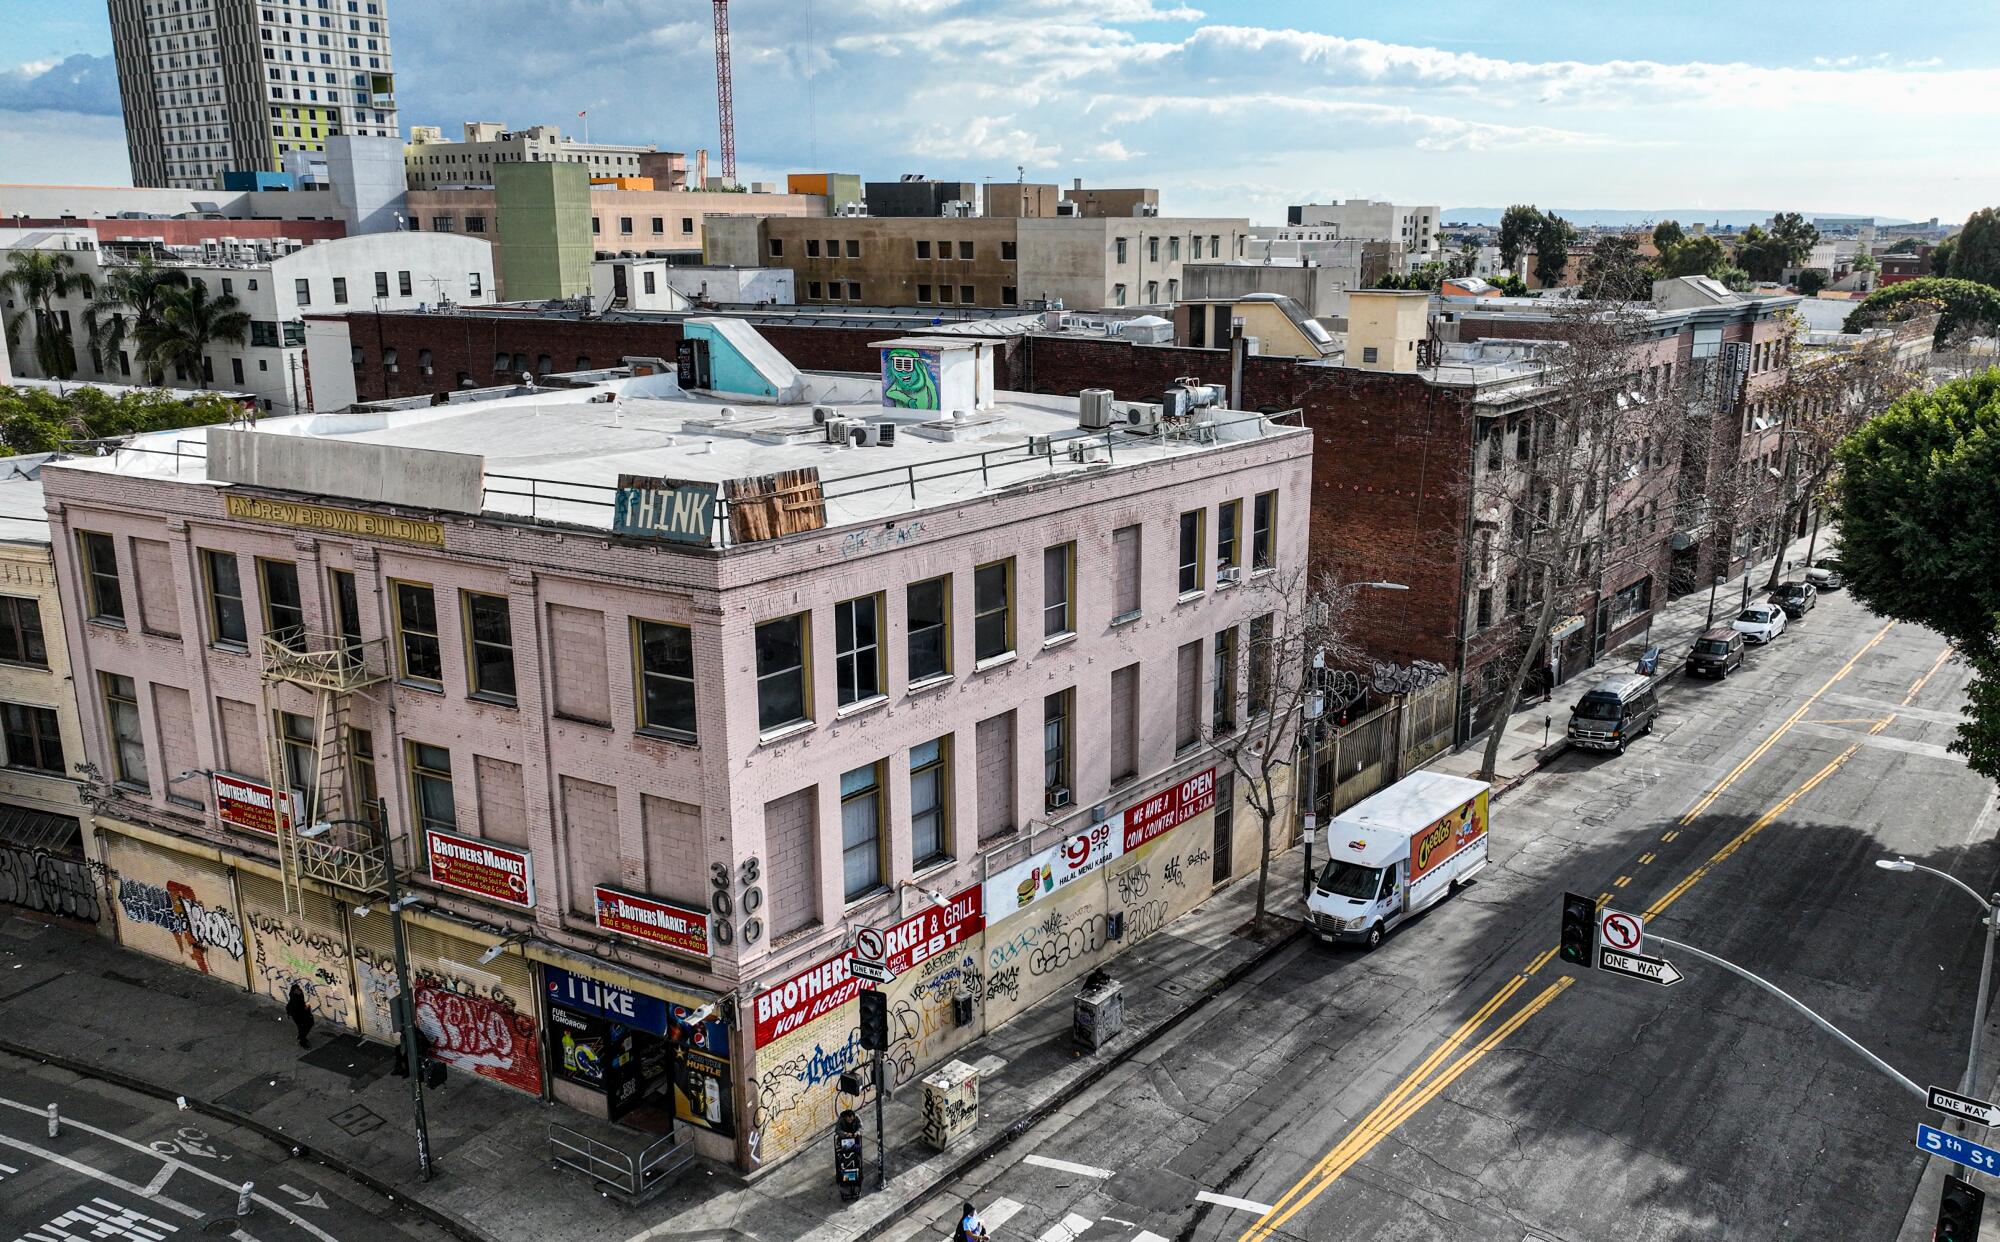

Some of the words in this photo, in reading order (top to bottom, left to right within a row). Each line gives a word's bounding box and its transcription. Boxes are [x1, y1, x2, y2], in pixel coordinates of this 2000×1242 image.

[233, 499, 298, 522] ANDREW
[302, 509, 359, 531] BROWN
[624, 488, 710, 535] THINK
[1182, 770, 1213, 802] OPEN
[1133, 807, 1144, 825] WE
[1145, 797, 1162, 819] HAVE
[1163, 794, 1169, 810] A
[1126, 826, 1144, 849] COIN
[1144, 810, 1175, 839] COUNTER
[1418, 819, 1452, 870] Cheetos
[1059, 871, 1077, 886] HALAL
[1078, 863, 1094, 878] MENU
[1095, 852, 1113, 868] KABAB
[711, 861, 733, 946] 300
[741, 856, 764, 945] 300
[603, 918, 614, 926] 300
[621, 922, 632, 931] 5th
[640, 927, 651, 936] Los
[678, 938, 688, 946] CA
[688, 941, 706, 951] 90013
[912, 925, 962, 965] EBT
[758, 952, 854, 1024] BROTHERS
[886, 915, 926, 959] RKET
[930, 914, 938, 935] &
[943, 896, 976, 927] GRILL
[854, 964, 868, 974] ONE
[869, 967, 883, 977] WAY
[890, 952, 906, 968] HOT
[1605, 954, 1629, 969] ONE
[1637, 962, 1662, 977] WAY
[552, 1007, 567, 1018] FUEL
[568, 977, 576, 999] I
[582, 981, 635, 1018] LIKE
[773, 1006, 809, 1038] NOW
[809, 977, 873, 1019] ACCEPTIN
[552, 1014, 587, 1031] TOMORROW
[686, 1060, 721, 1077] HUSTLE
[1937, 1096, 1960, 1110] ONE
[1964, 1103, 1988, 1117] WAY
[1926, 1132, 1962, 1152] 5th
[1970, 1149, 1994, 1169] St
